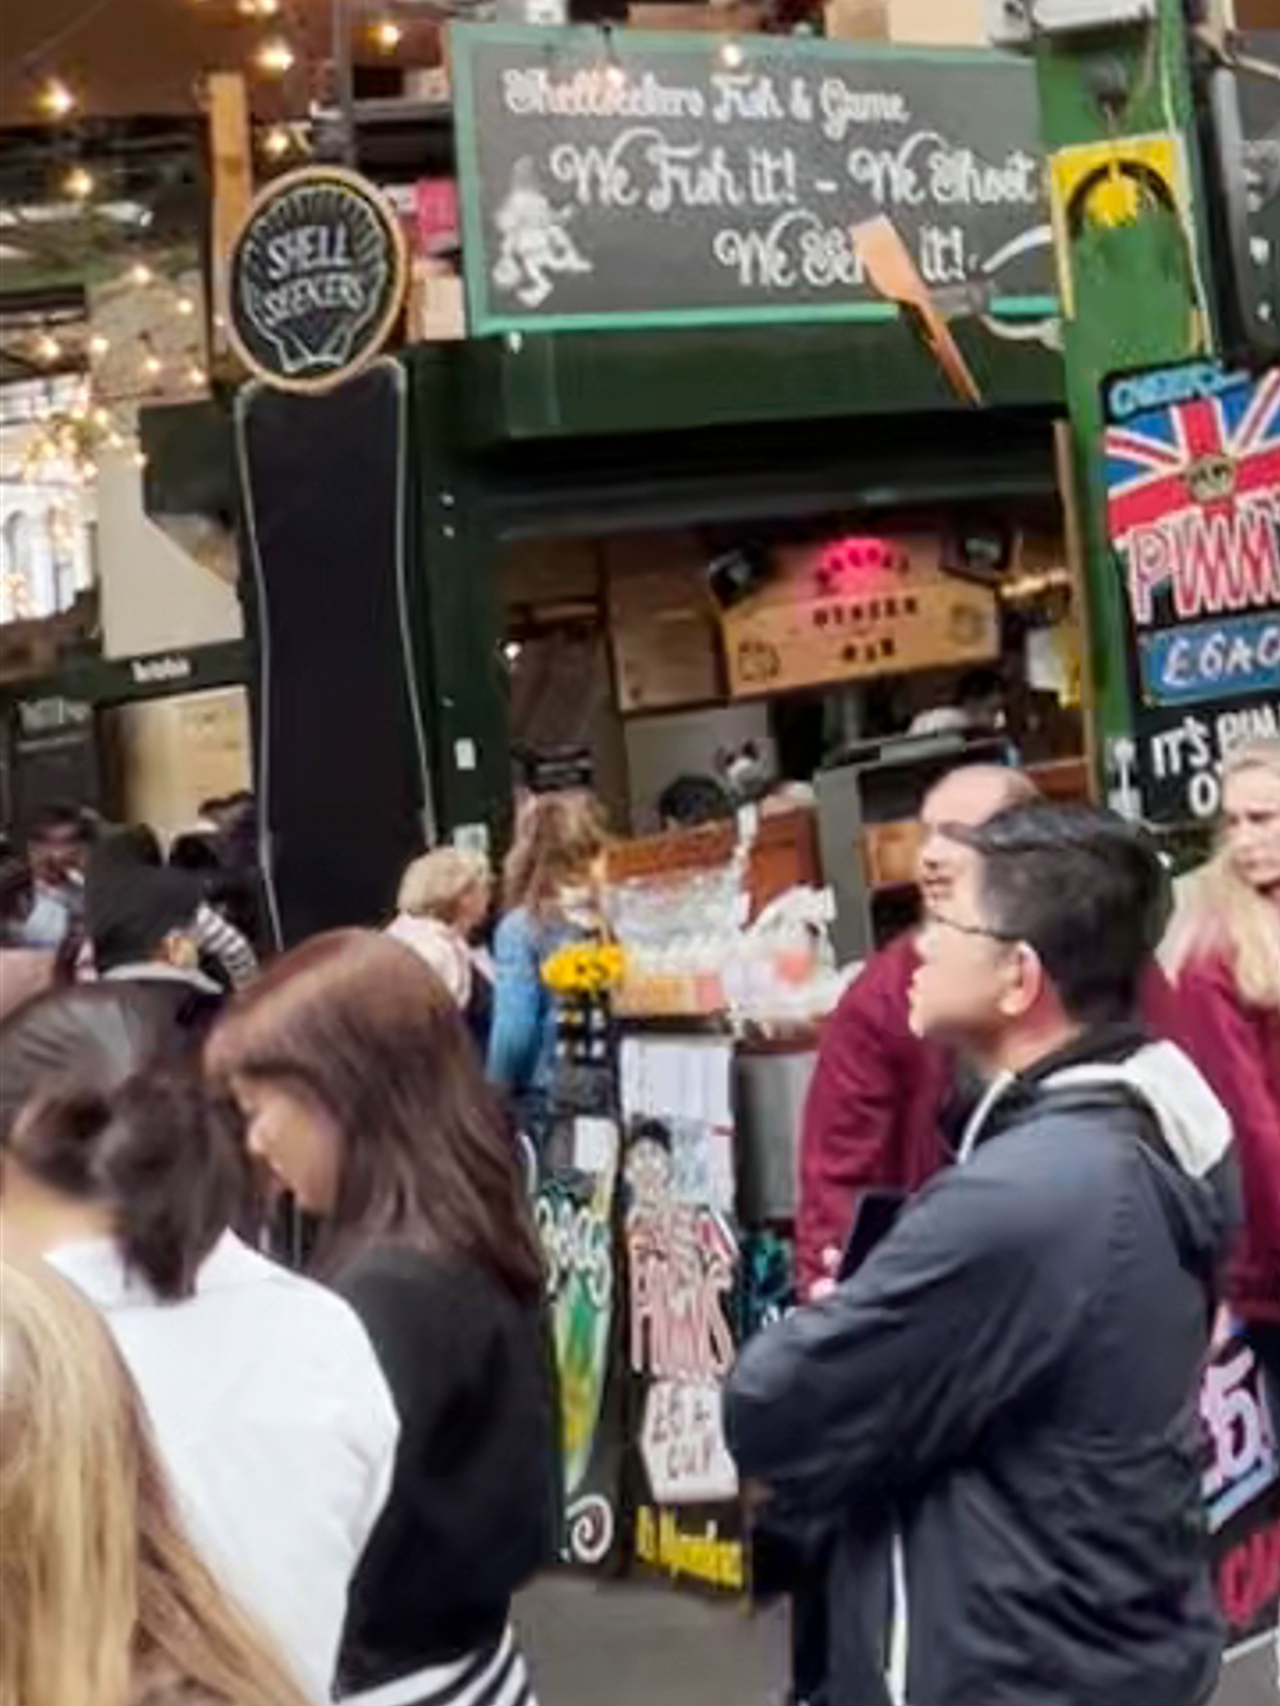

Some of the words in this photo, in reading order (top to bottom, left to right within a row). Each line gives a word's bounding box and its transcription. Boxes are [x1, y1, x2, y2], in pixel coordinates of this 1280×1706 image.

[710, 70, 786, 125] Fish
[790, 79, 814, 121] &
[551, 126, 662, 206] We
[647, 139, 746, 213] Fish
[847, 131, 948, 206] We
[927, 146, 1039, 206] Shoot
[267, 222, 350, 281] SHELL
[712, 209, 824, 288] We
